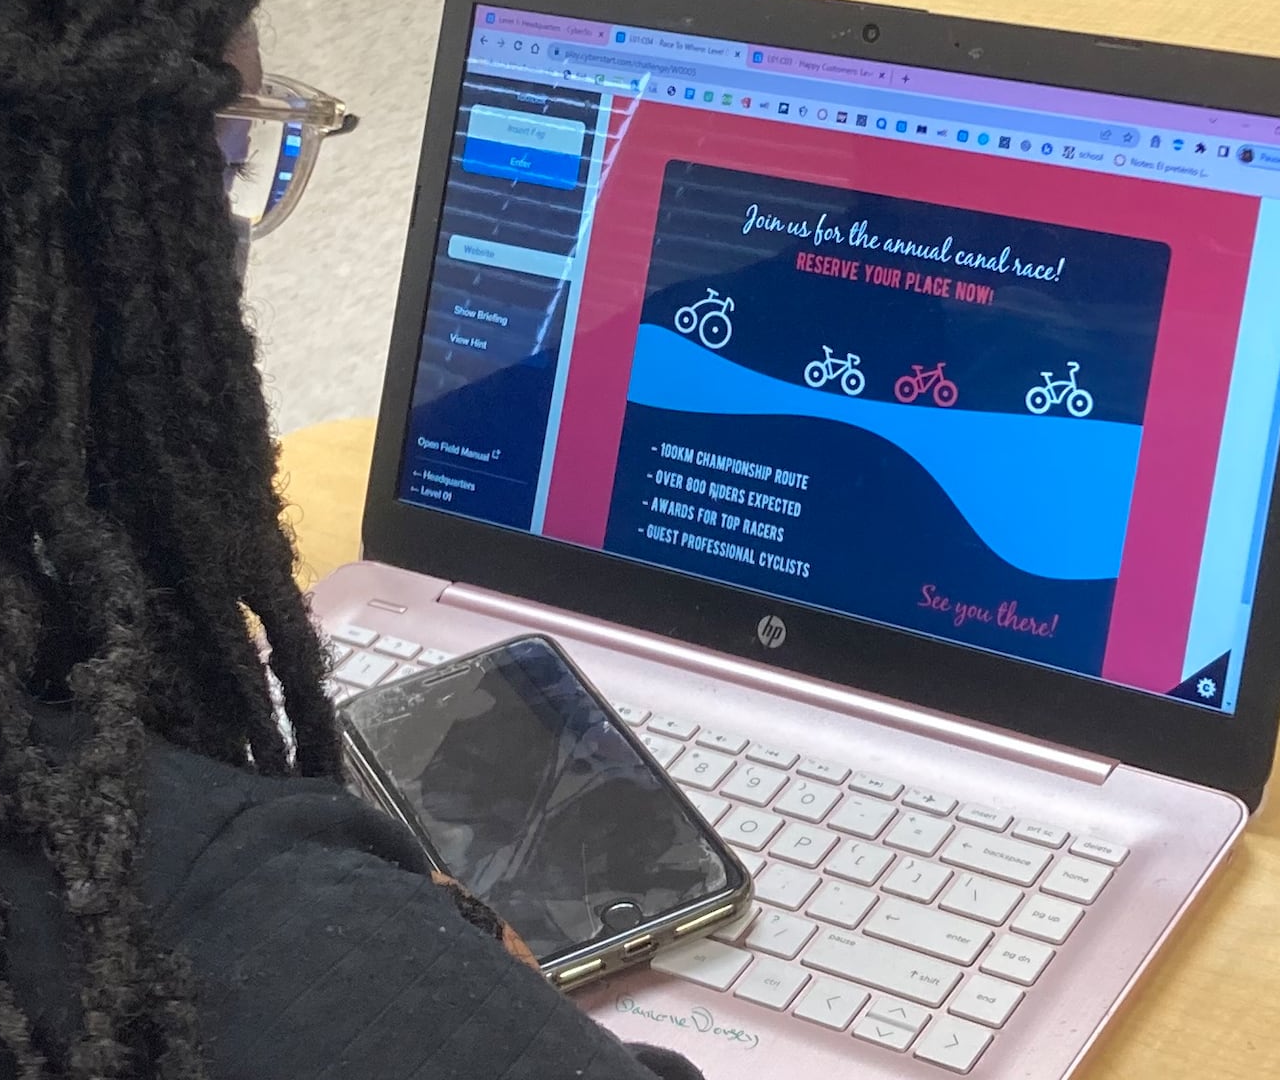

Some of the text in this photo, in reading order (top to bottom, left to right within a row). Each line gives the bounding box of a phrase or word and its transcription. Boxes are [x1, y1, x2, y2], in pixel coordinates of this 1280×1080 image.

[798, 60, 820, 72] Happy
[510, 157, 532, 168] Enter
[1078, 150, 1104, 161] school
[742, 203, 1066, 282] Join us for the annual canal race!
[464, 244, 495, 259] Website
[796, 251, 995, 306] RESERVE YOUR PLACE NOW!
[453, 305, 509, 327] Show Briefing
[449, 333, 488, 350] View Hint
[417, 436, 490, 462] Open Field Manual
[660, 442, 694, 464] 100KM
[695, 450, 773, 481] CHAMPIONSHIP
[774, 468, 810, 491] ROUTE
[422, 469, 476, 492] Headquarters
[420, 485, 453, 502] Level 01
[655, 469, 683, 489] OVER
[685, 476, 707, 495] 800
[708, 482, 746, 505] RIDERS
[747, 491, 802, 517] EXPECTED
[651, 496, 695, 520] AWARDS
[697, 507, 718, 526] FOR
[721, 513, 741, 531] TOP
[742, 518, 785, 542] RACERS
[646, 524, 680, 545] GUEST
[680, 532, 756, 565] PROFESSIONAL
[758, 551, 811, 579] CYCLISTS
[917, 584, 1060, 638] See you there!
[760, 615, 785, 647] hp
[694, 762, 709, 773] 8
[746, 777, 761, 788] 9
[971, 809, 997, 821] insert
[1026, 825, 1054, 837] prt sc
[794, 836, 812, 848] P
[1083, 841, 1113, 855] delete
[983, 847, 1032, 866] backspace
[1062, 870, 1090, 883] home
[1031, 909, 1063, 924] pg up
[828, 933, 857, 947] pause
[946, 933, 972, 944] enter
[1002, 950, 1031, 964] pg dn
[763, 977, 781, 988] ctrl
[919, 970, 941, 986] shift
[976, 992, 997, 1004] end
